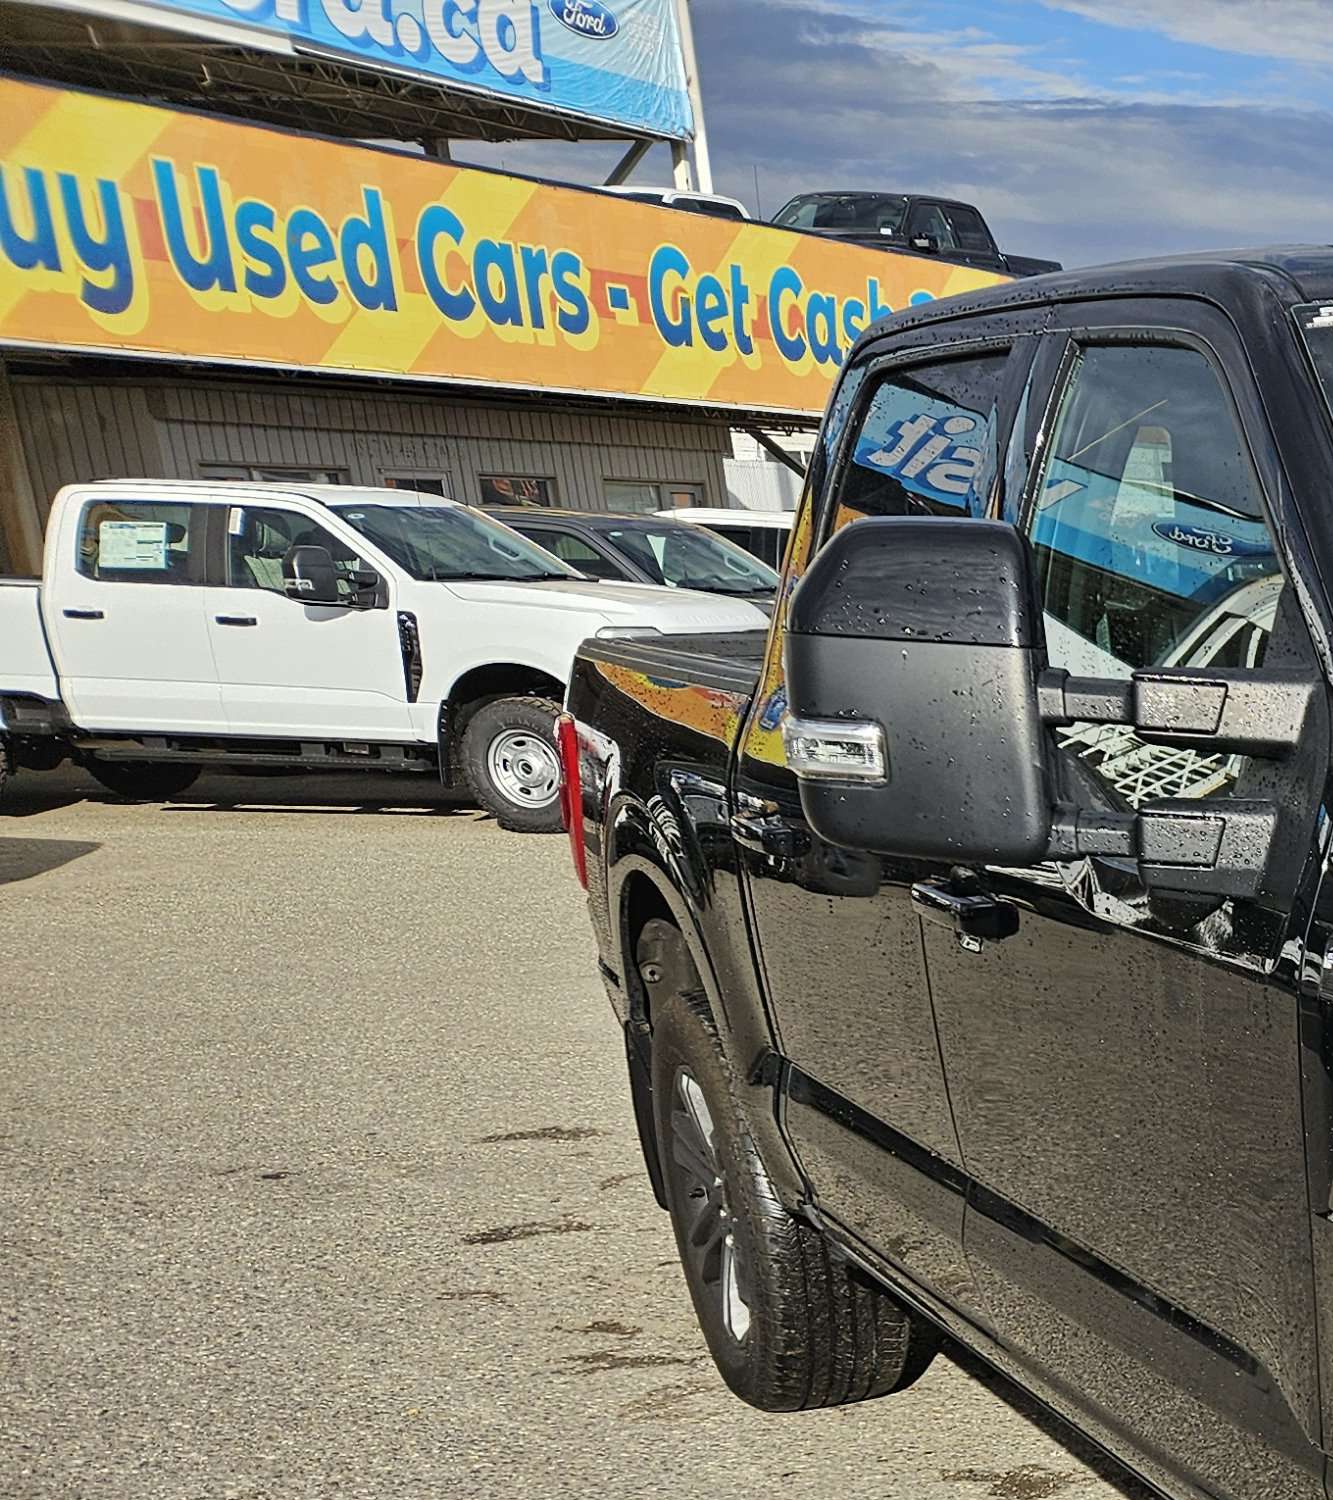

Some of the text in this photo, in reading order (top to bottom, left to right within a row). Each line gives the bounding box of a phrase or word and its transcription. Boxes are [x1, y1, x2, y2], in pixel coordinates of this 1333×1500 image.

[563, 0, 605, 33] Ford
[152, 158, 398, 312] Used
[416, 206, 589, 336] Cars
[649, 245, 753, 356] Get
